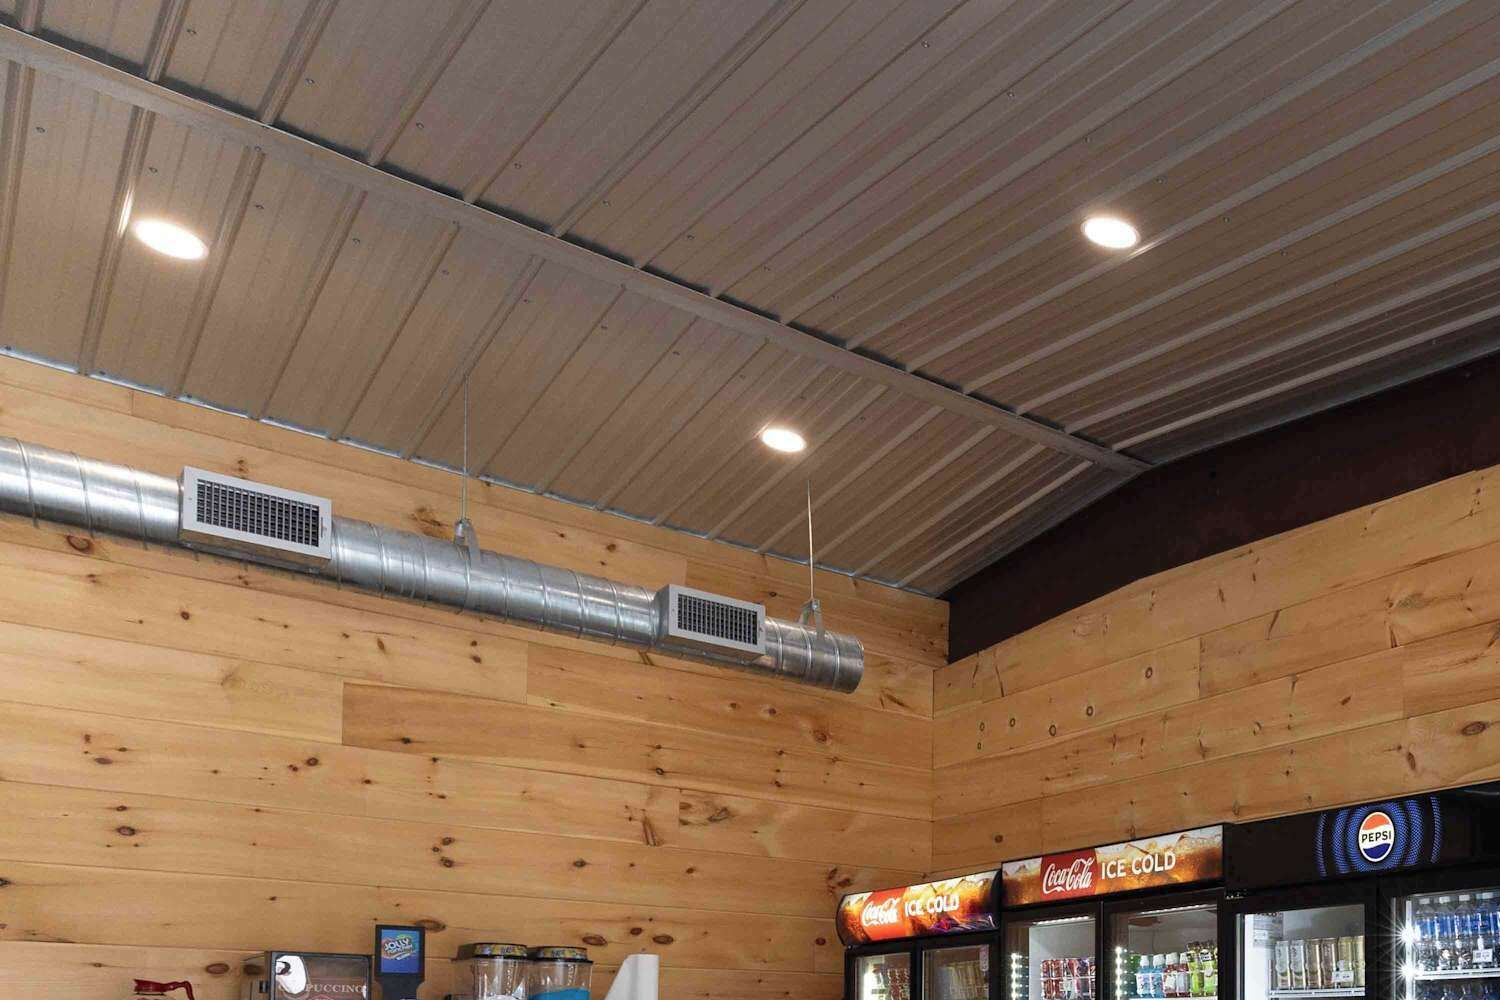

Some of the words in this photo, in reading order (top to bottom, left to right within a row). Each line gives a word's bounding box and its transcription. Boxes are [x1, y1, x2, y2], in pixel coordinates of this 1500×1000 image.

[1361, 830, 1391, 843] PEPSI
[1101, 859, 1128, 880] ICE
[1131, 851, 1177, 876] COLD
[904, 899, 926, 917] ICE
[928, 895, 960, 914] COLD
